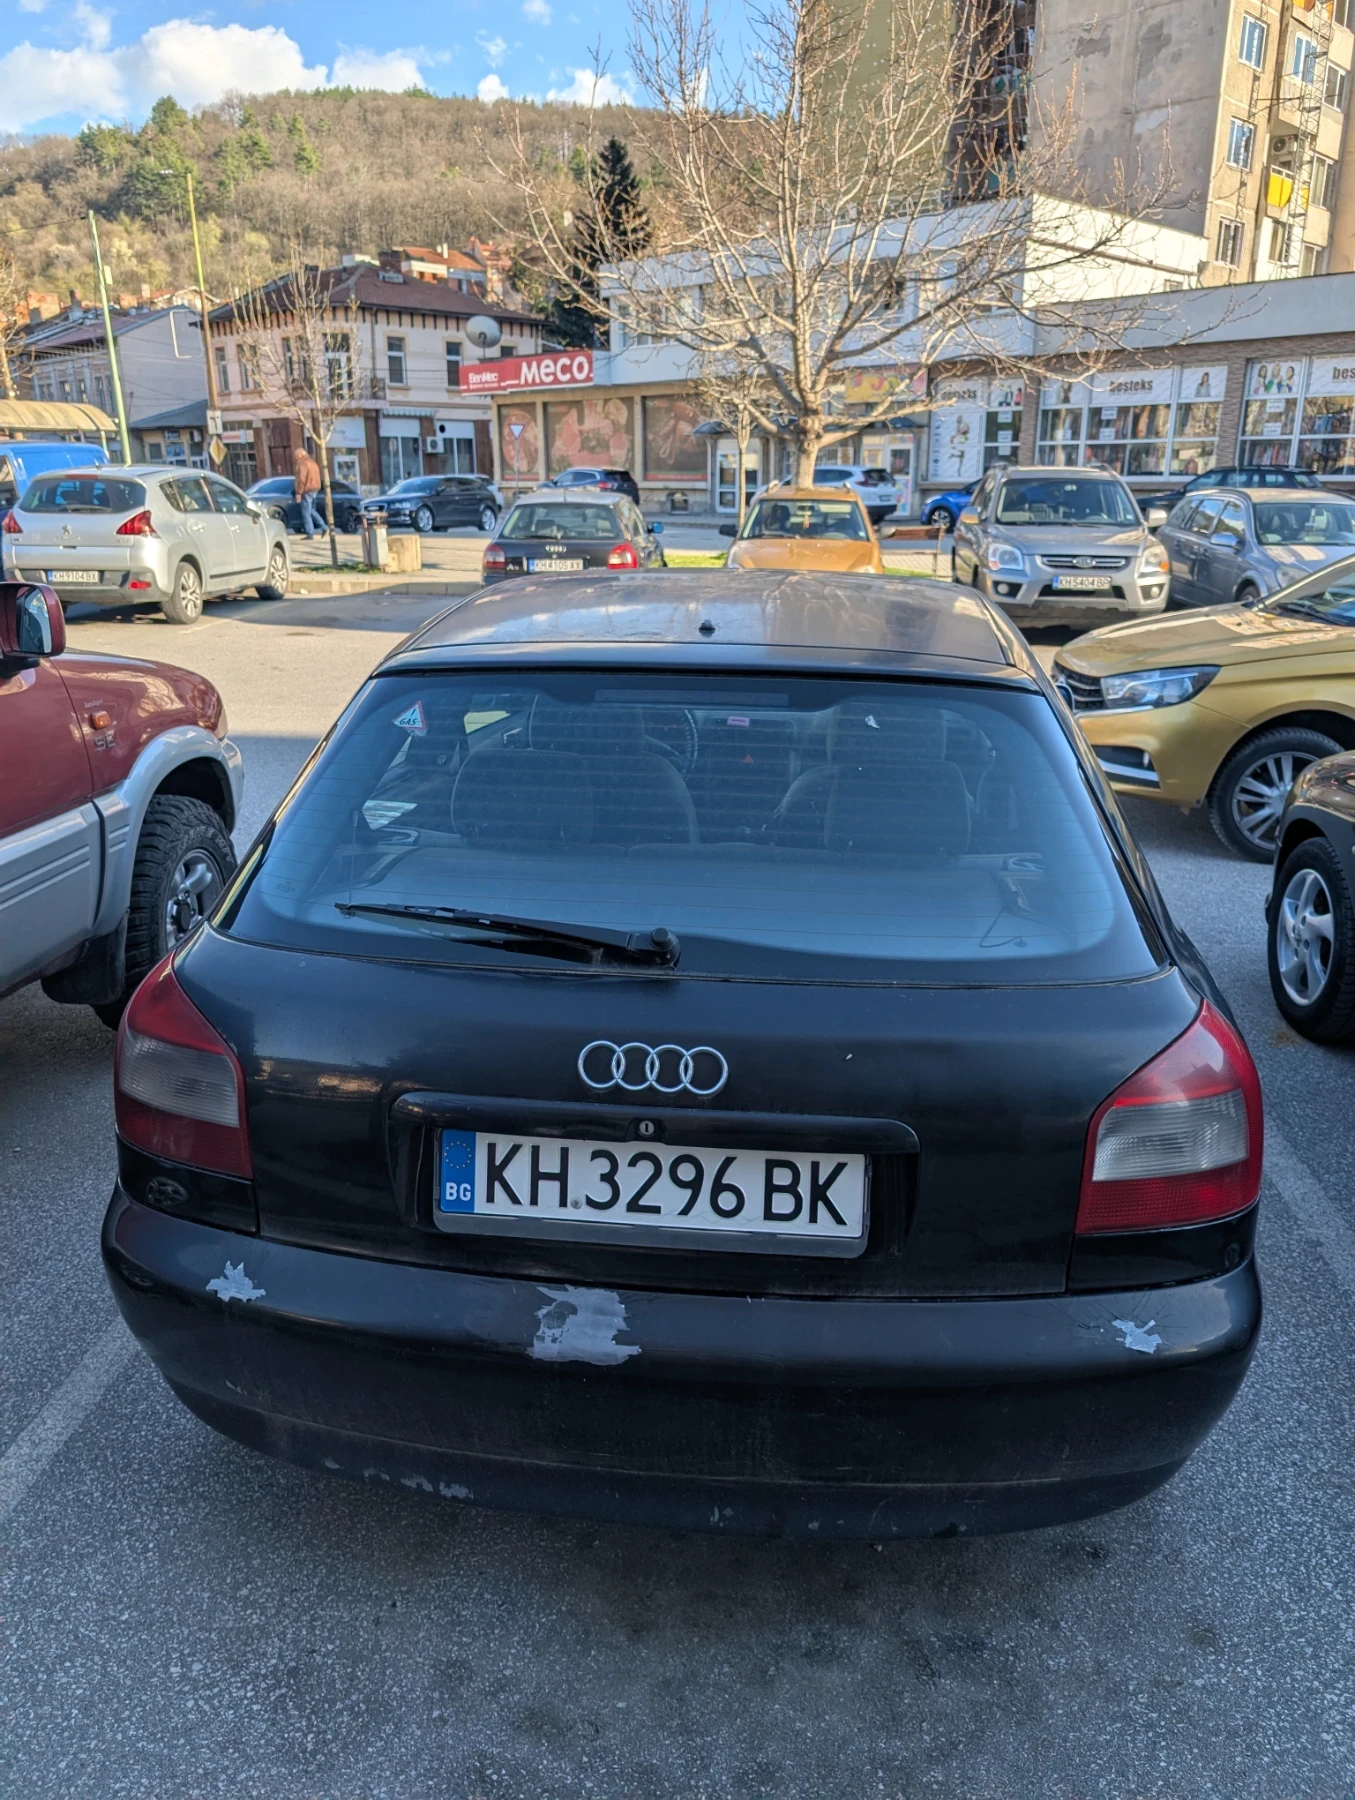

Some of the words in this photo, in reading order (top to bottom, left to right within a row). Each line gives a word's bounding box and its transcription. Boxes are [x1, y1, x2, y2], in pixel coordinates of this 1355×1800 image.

[399, 717, 418, 726] GAS
[446, 1182, 472, 1202] BG
[486, 1142, 569, 1208] KH
[585, 1149, 746, 1219] 3296
[763, 1158, 849, 1226] BK
